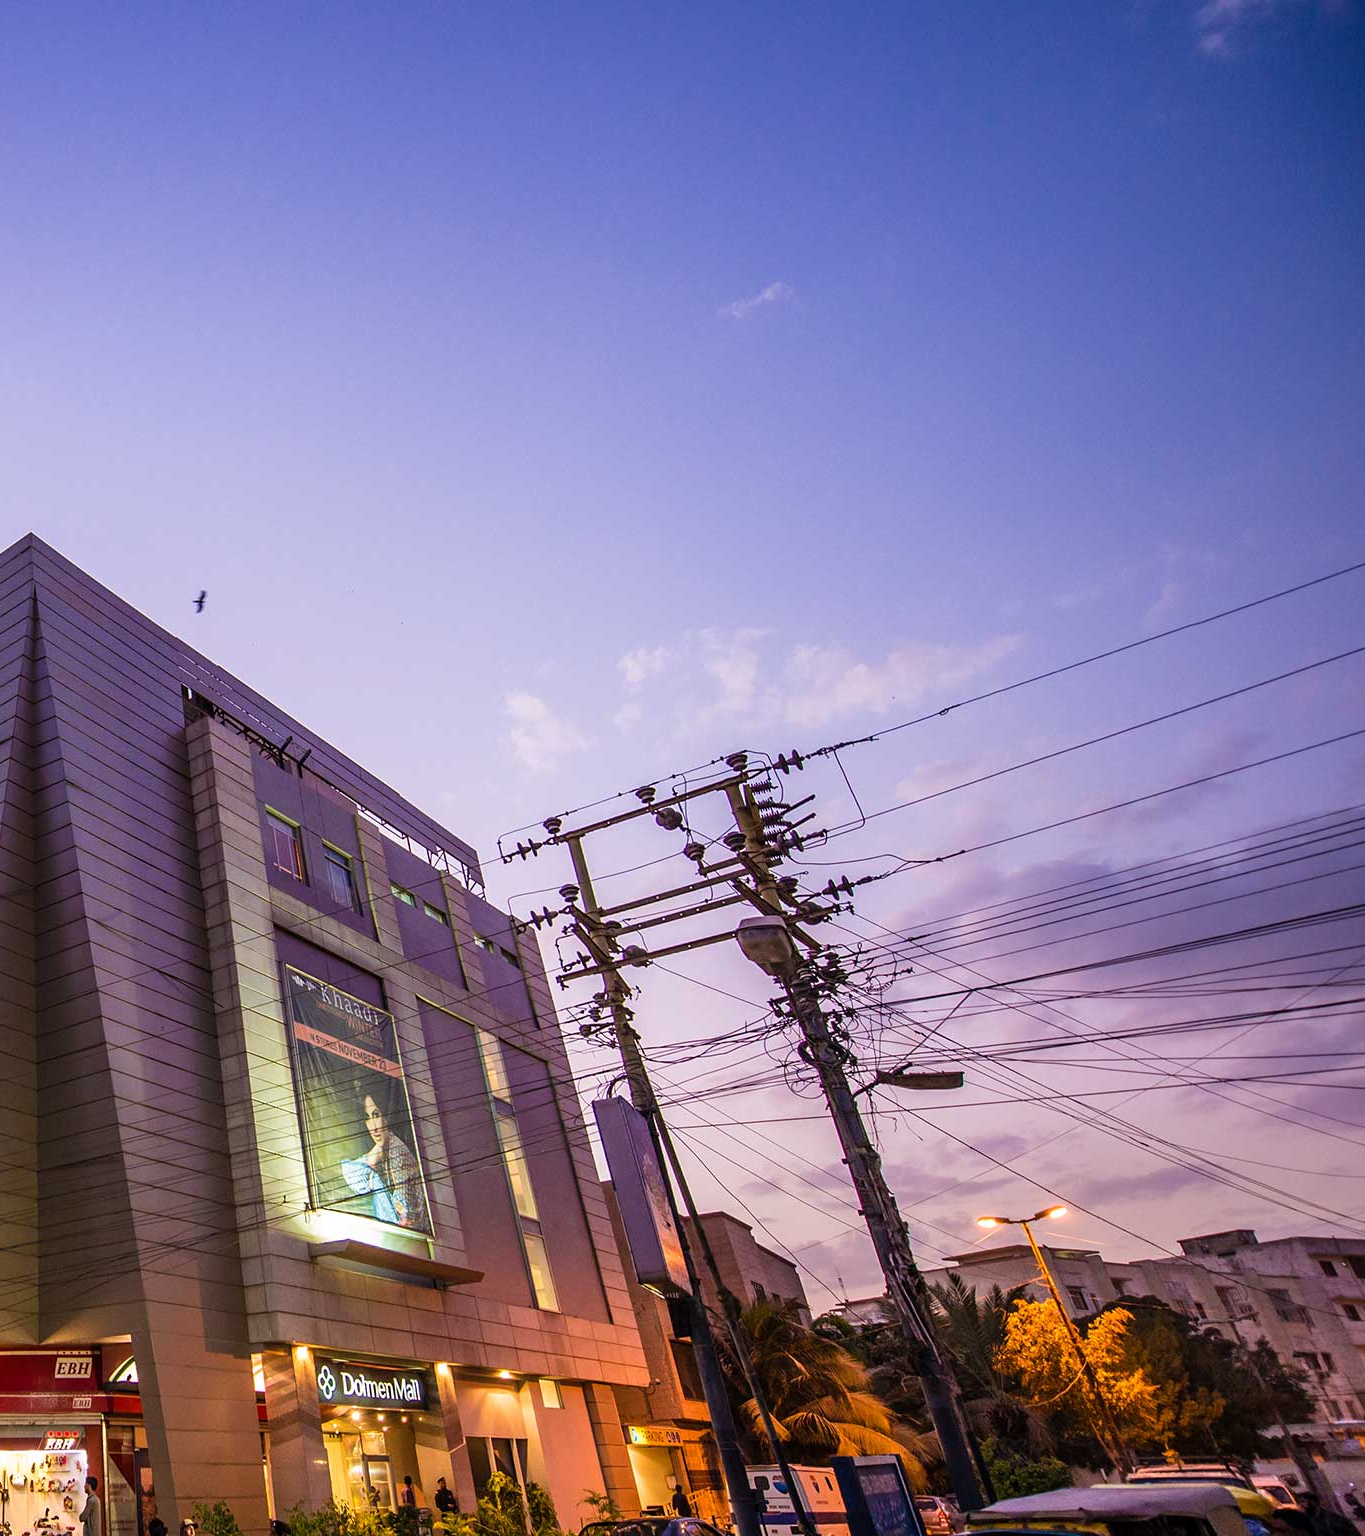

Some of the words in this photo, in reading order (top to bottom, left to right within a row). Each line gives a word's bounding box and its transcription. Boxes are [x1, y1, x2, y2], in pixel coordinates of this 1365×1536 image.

[321, 984, 379, 1025] Khaadi
[338, 1042, 377, 1065] NOVEMBER
[57, 1362, 90, 1374] EBH
[44, 1438, 75, 1450] EBH
